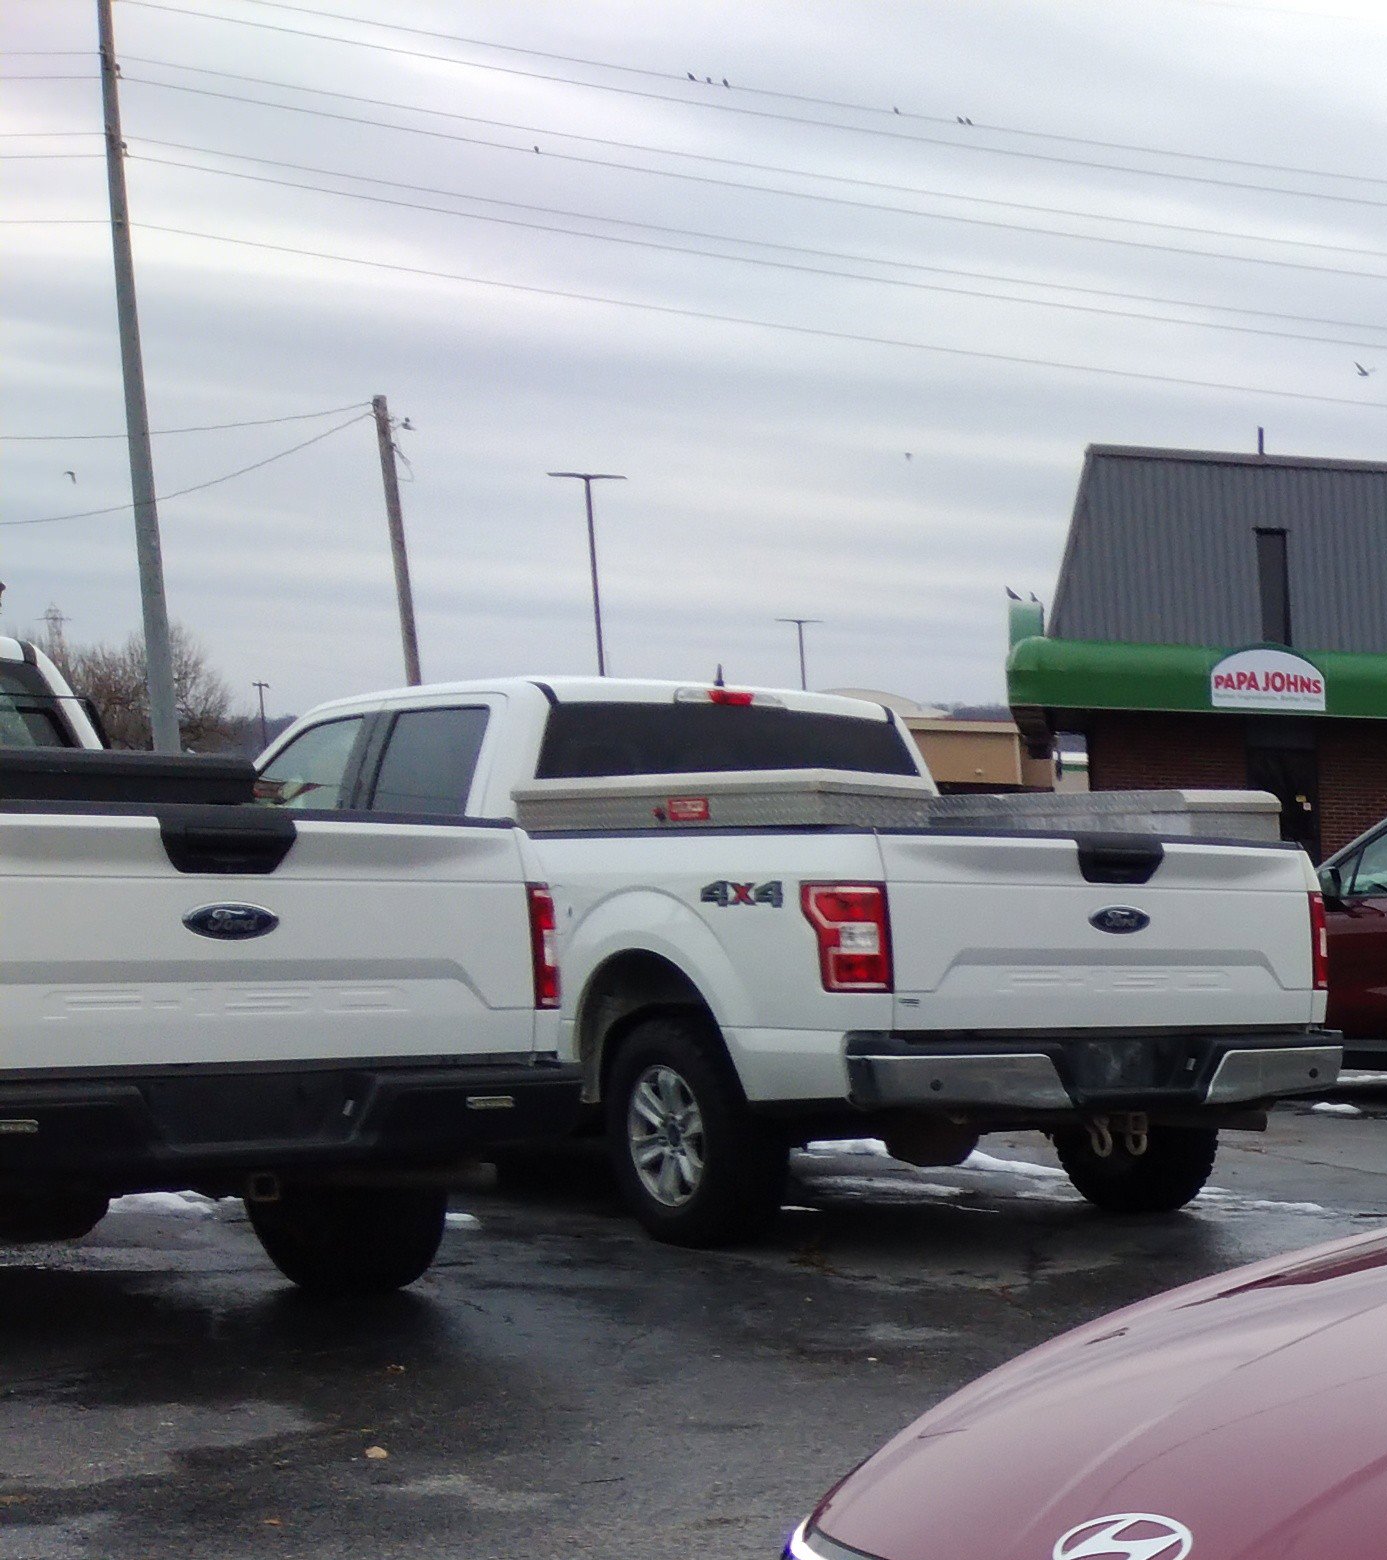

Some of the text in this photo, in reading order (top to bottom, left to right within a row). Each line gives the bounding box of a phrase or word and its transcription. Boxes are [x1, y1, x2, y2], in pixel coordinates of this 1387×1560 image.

[1214, 672, 1322, 694] PAPA JOHNS
[207, 908, 258, 931] Ford
